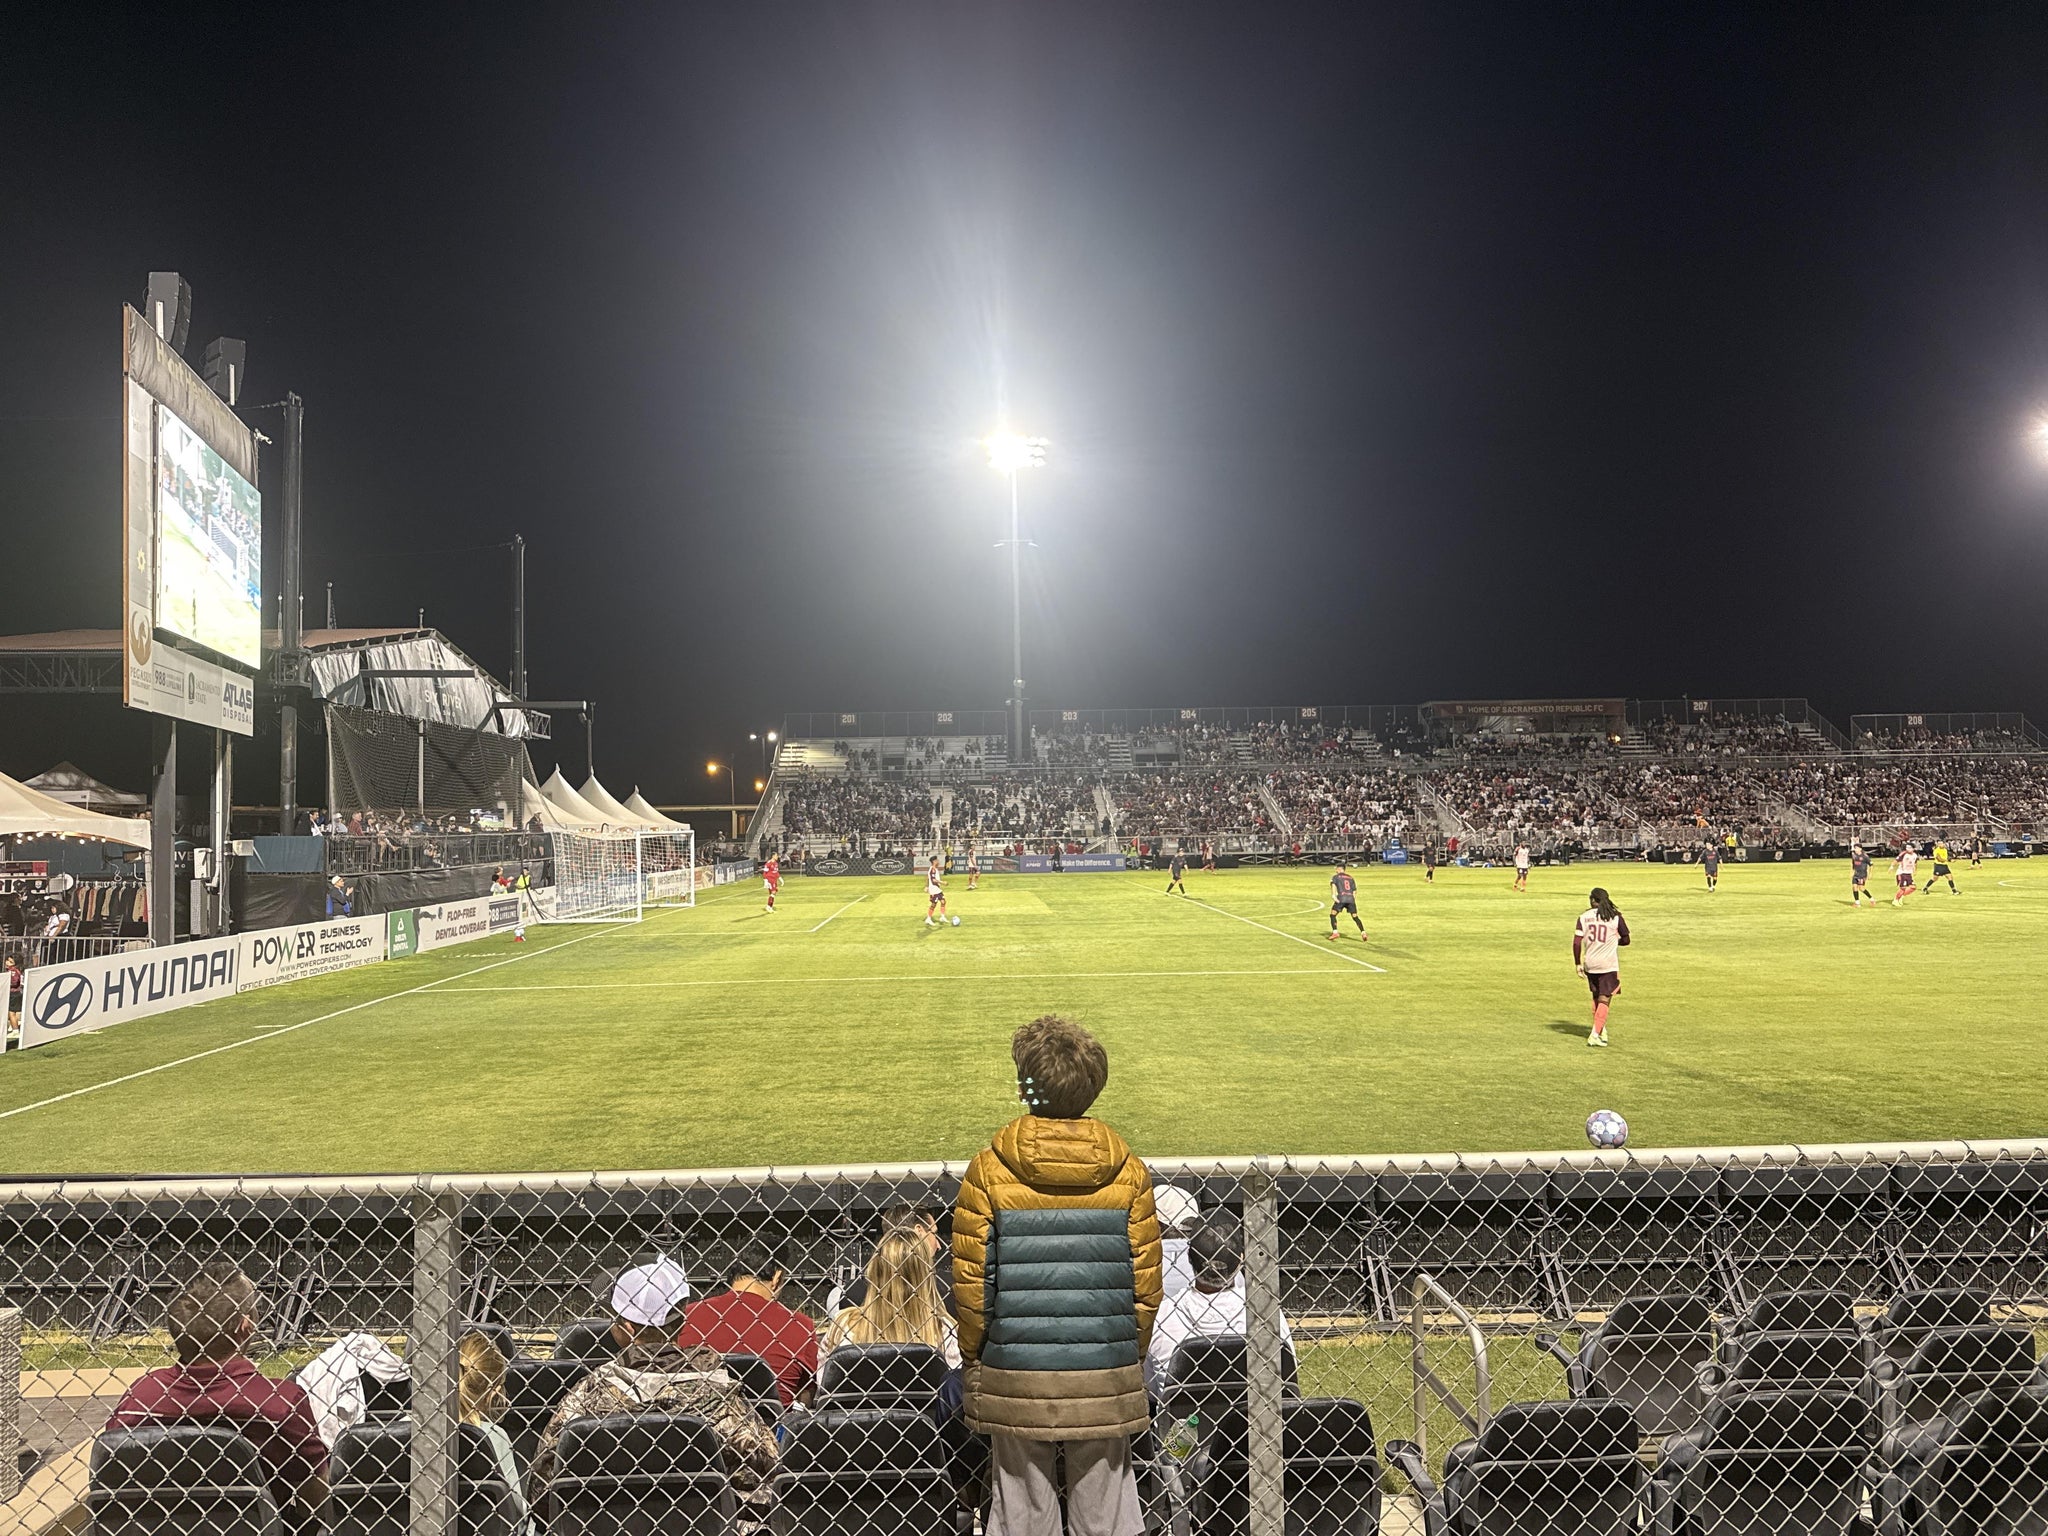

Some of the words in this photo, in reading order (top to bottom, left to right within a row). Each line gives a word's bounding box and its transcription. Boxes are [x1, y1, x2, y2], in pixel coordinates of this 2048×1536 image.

[154, 670, 166, 686] 988
[223, 682, 253, 713] ATLAS
[1302, 708, 1317, 718] 205
[1468, 705, 1490, 714] HOME
[1491, 705, 1501, 714] OF
[1502, 705, 1554, 714] SACRAMENTO
[1556, 704, 1593, 713] REPUBLIC
[1594, 704, 1604, 712] FC
[1693, 701, 1708, 711] 207
[223, 707, 252, 725] DISPOSAL
[842, 714, 856, 724] 201
[937, 713, 953, 722] 202
[1062, 711, 1078, 721] 203
[1181, 710, 1197, 719] 204
[1907, 715, 1923, 725] 208
[447, 907, 477, 922] FLOP-FREE
[320, 924, 361, 940] BUSINESS
[435, 927, 458, 940] DENTAL
[458, 920, 487, 936] COVERAGE
[1588, 924, 1607, 943] 30
[253, 927, 316, 974] POWER
[319, 936, 374, 955] TECHNOLOGY
[279, 954, 352, 973] WWW.POWERCOPIERS.COM
[102, 949, 235, 1012] HYUNDAI
[240, 980, 262, 992] OFFICE
[264, 972, 299, 985] EQUIPMENT
[309, 966, 329, 975] COVER
[345, 959, 362, 967] OFFICE
